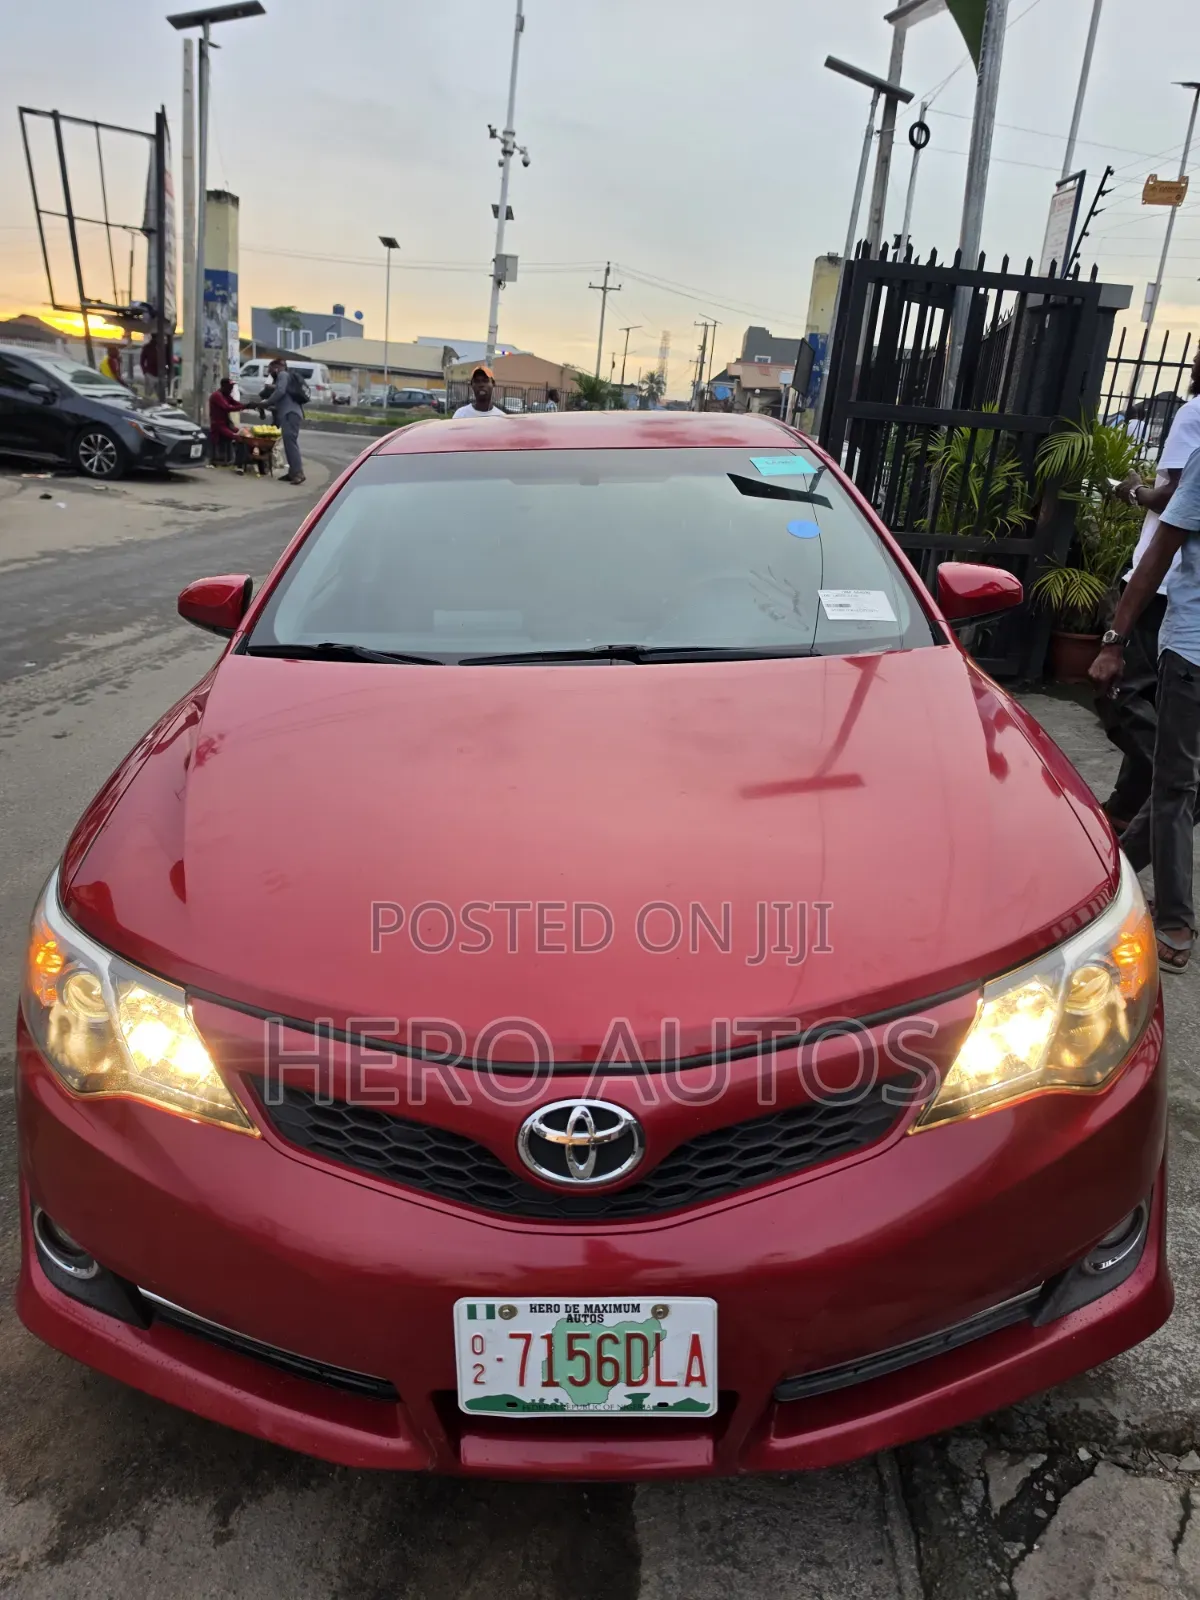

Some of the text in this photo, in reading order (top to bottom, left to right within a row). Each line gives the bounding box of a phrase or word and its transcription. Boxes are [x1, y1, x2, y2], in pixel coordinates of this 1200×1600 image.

[529, 1303, 641, 1313] HERO DE MAXIMUM
[566, 1314, 604, 1323] AUTOS
